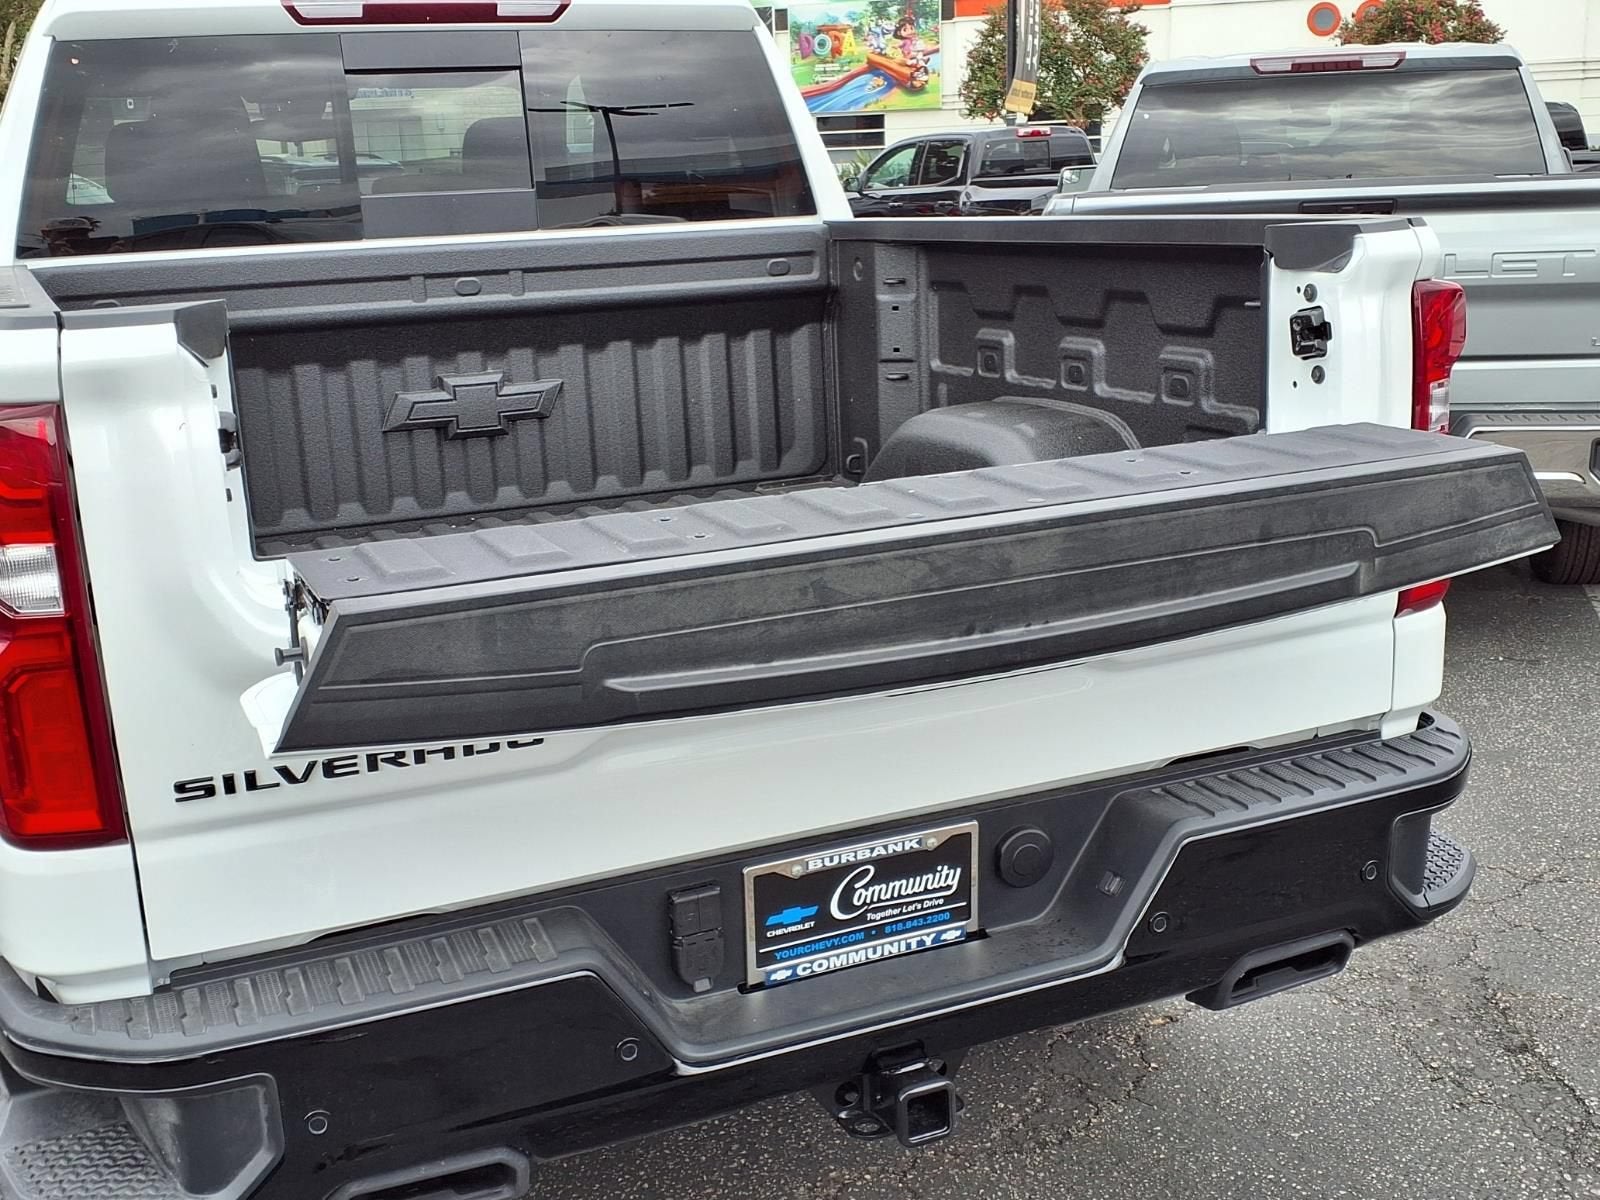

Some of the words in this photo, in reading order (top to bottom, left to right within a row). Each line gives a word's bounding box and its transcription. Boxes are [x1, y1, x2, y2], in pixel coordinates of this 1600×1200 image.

[799, 29, 857, 59] DORA
[807, 837, 921, 870] BURBANK
[830, 865, 962, 920] Community
[866, 906, 901, 922] Together
[902, 902, 922, 914] Let's
[923, 898, 944, 909] Drive
[766, 920, 815, 938] CHEVROLET
[774, 931, 865, 960] YOURCHEVY.COM
[884, 911, 950, 935] 818.843.2200
[796, 932, 937, 977] COMMUNITY
